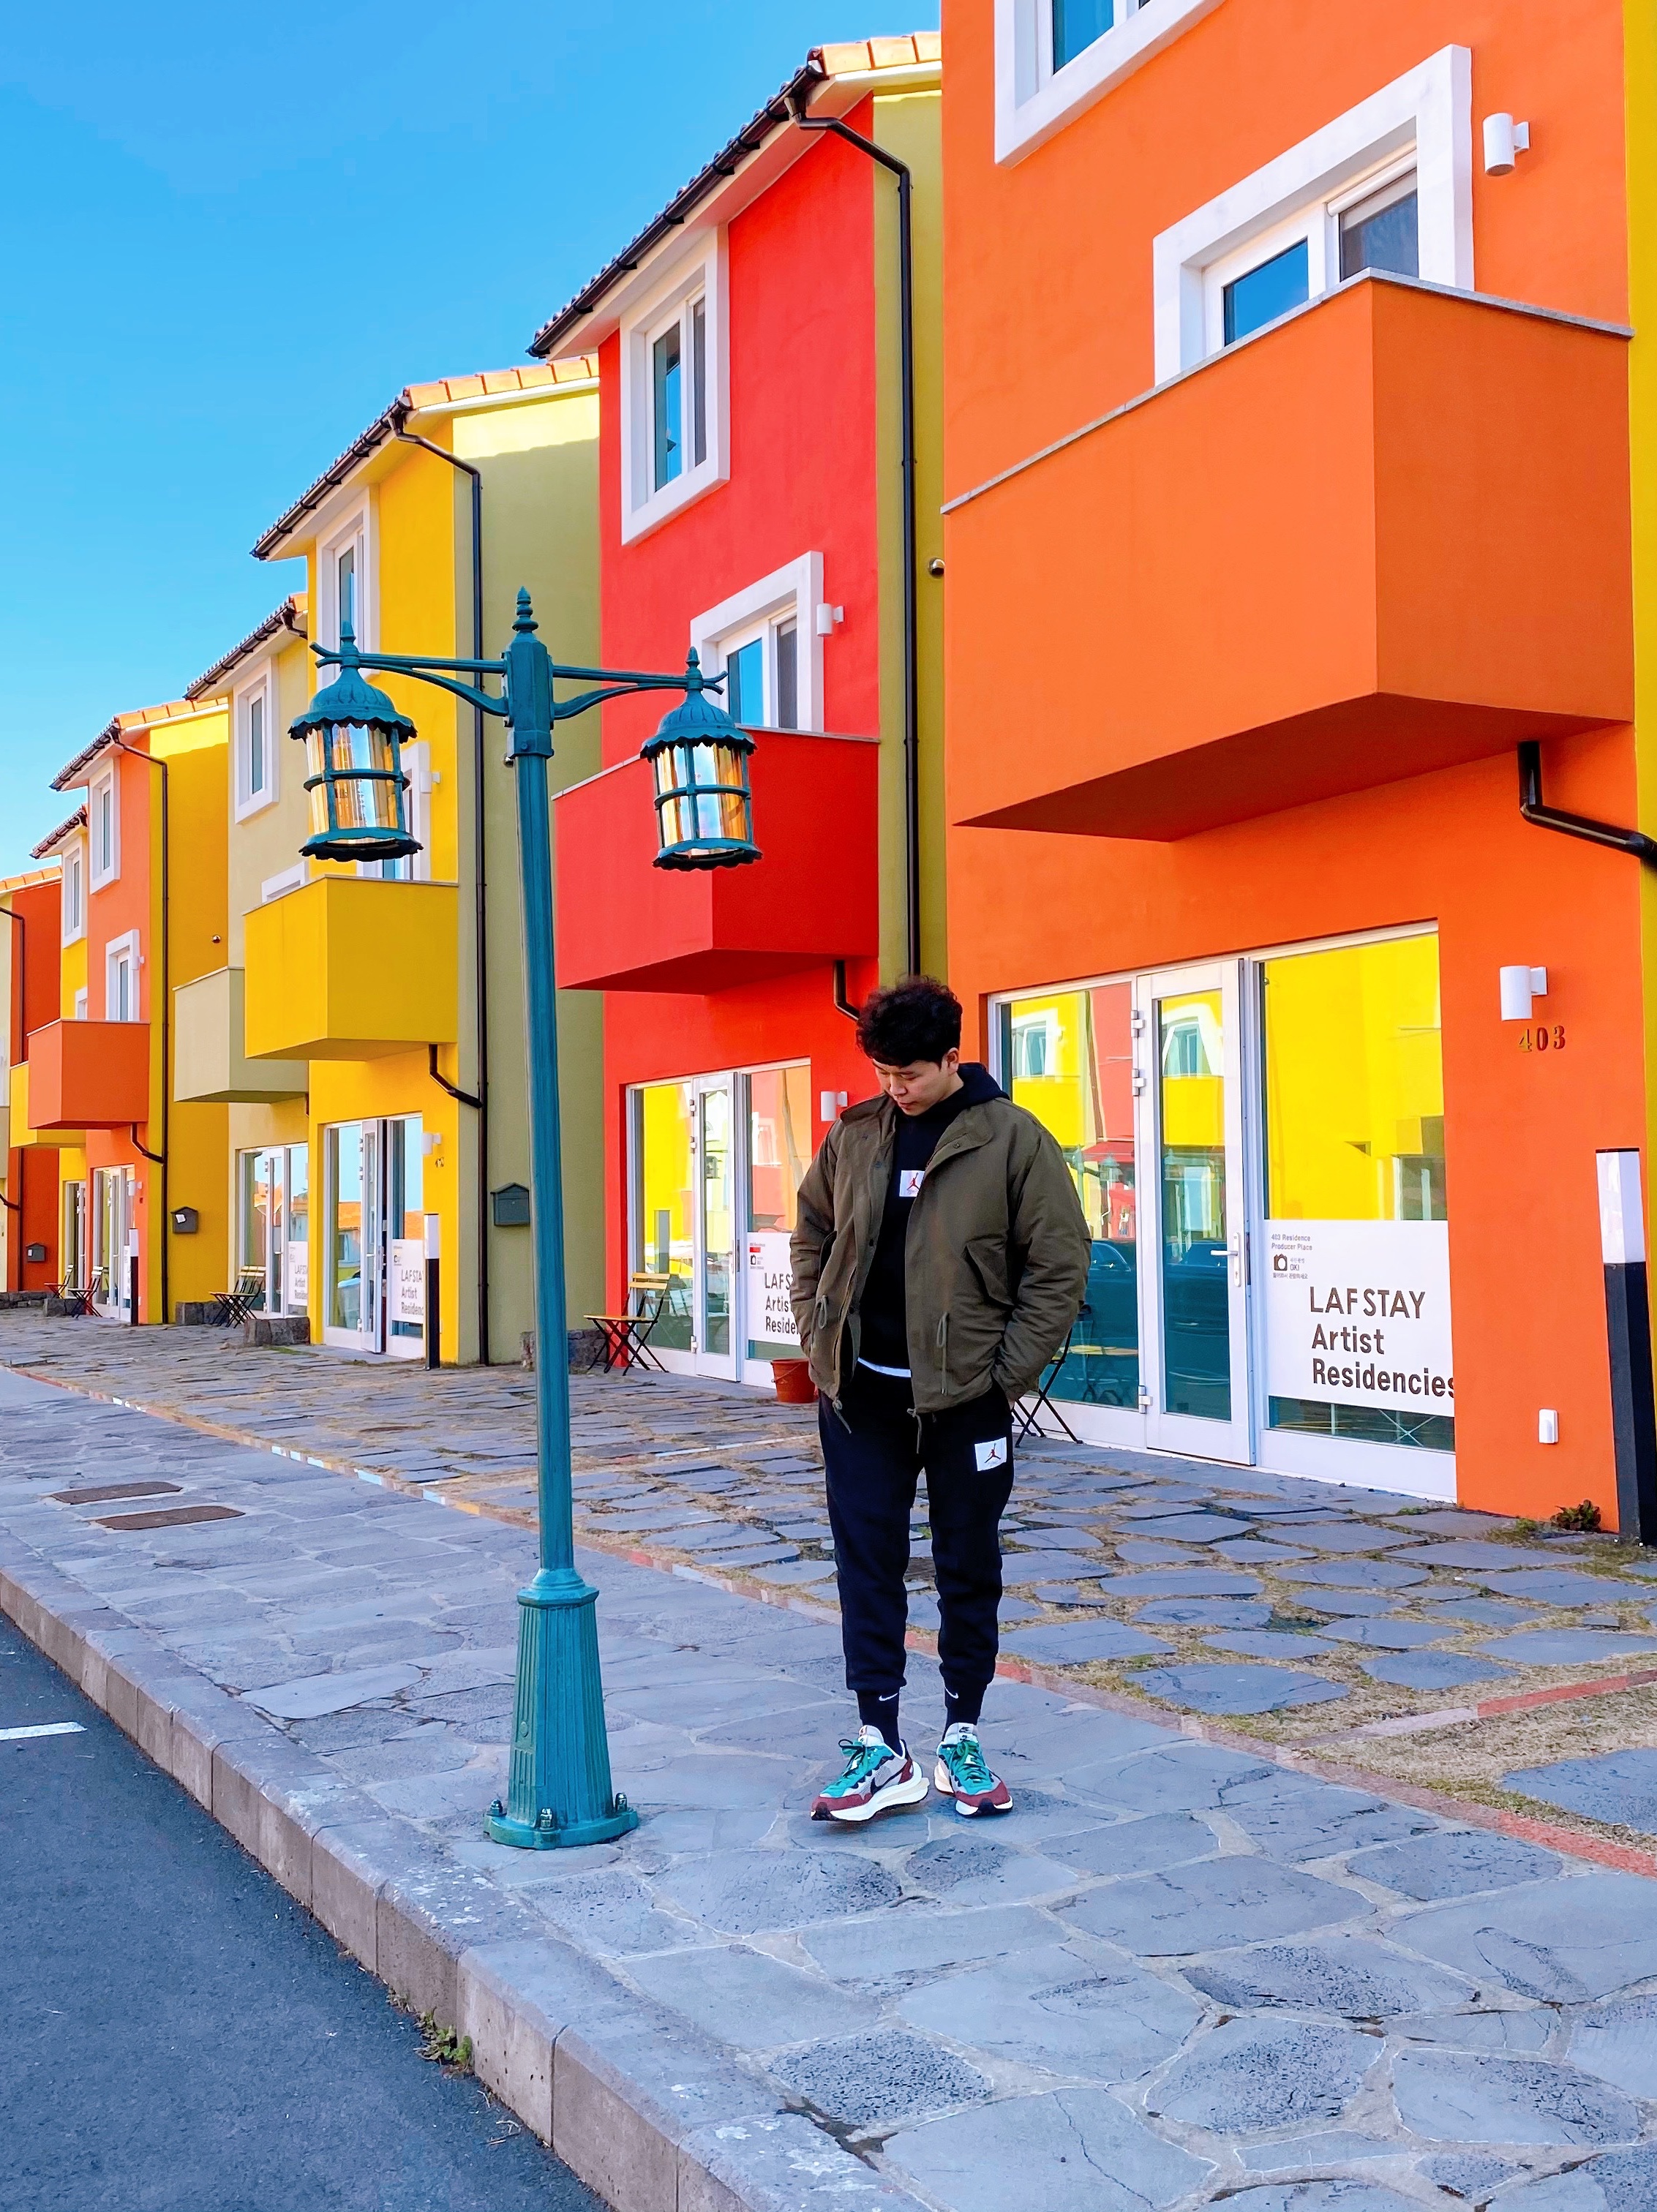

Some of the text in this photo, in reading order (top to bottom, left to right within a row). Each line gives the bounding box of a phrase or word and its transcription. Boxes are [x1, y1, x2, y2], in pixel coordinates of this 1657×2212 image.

[1518, 1026, 1566, 1053] 403
[765, 1295, 790, 1312] Artis
[1312, 1323, 1384, 1355] Artist
